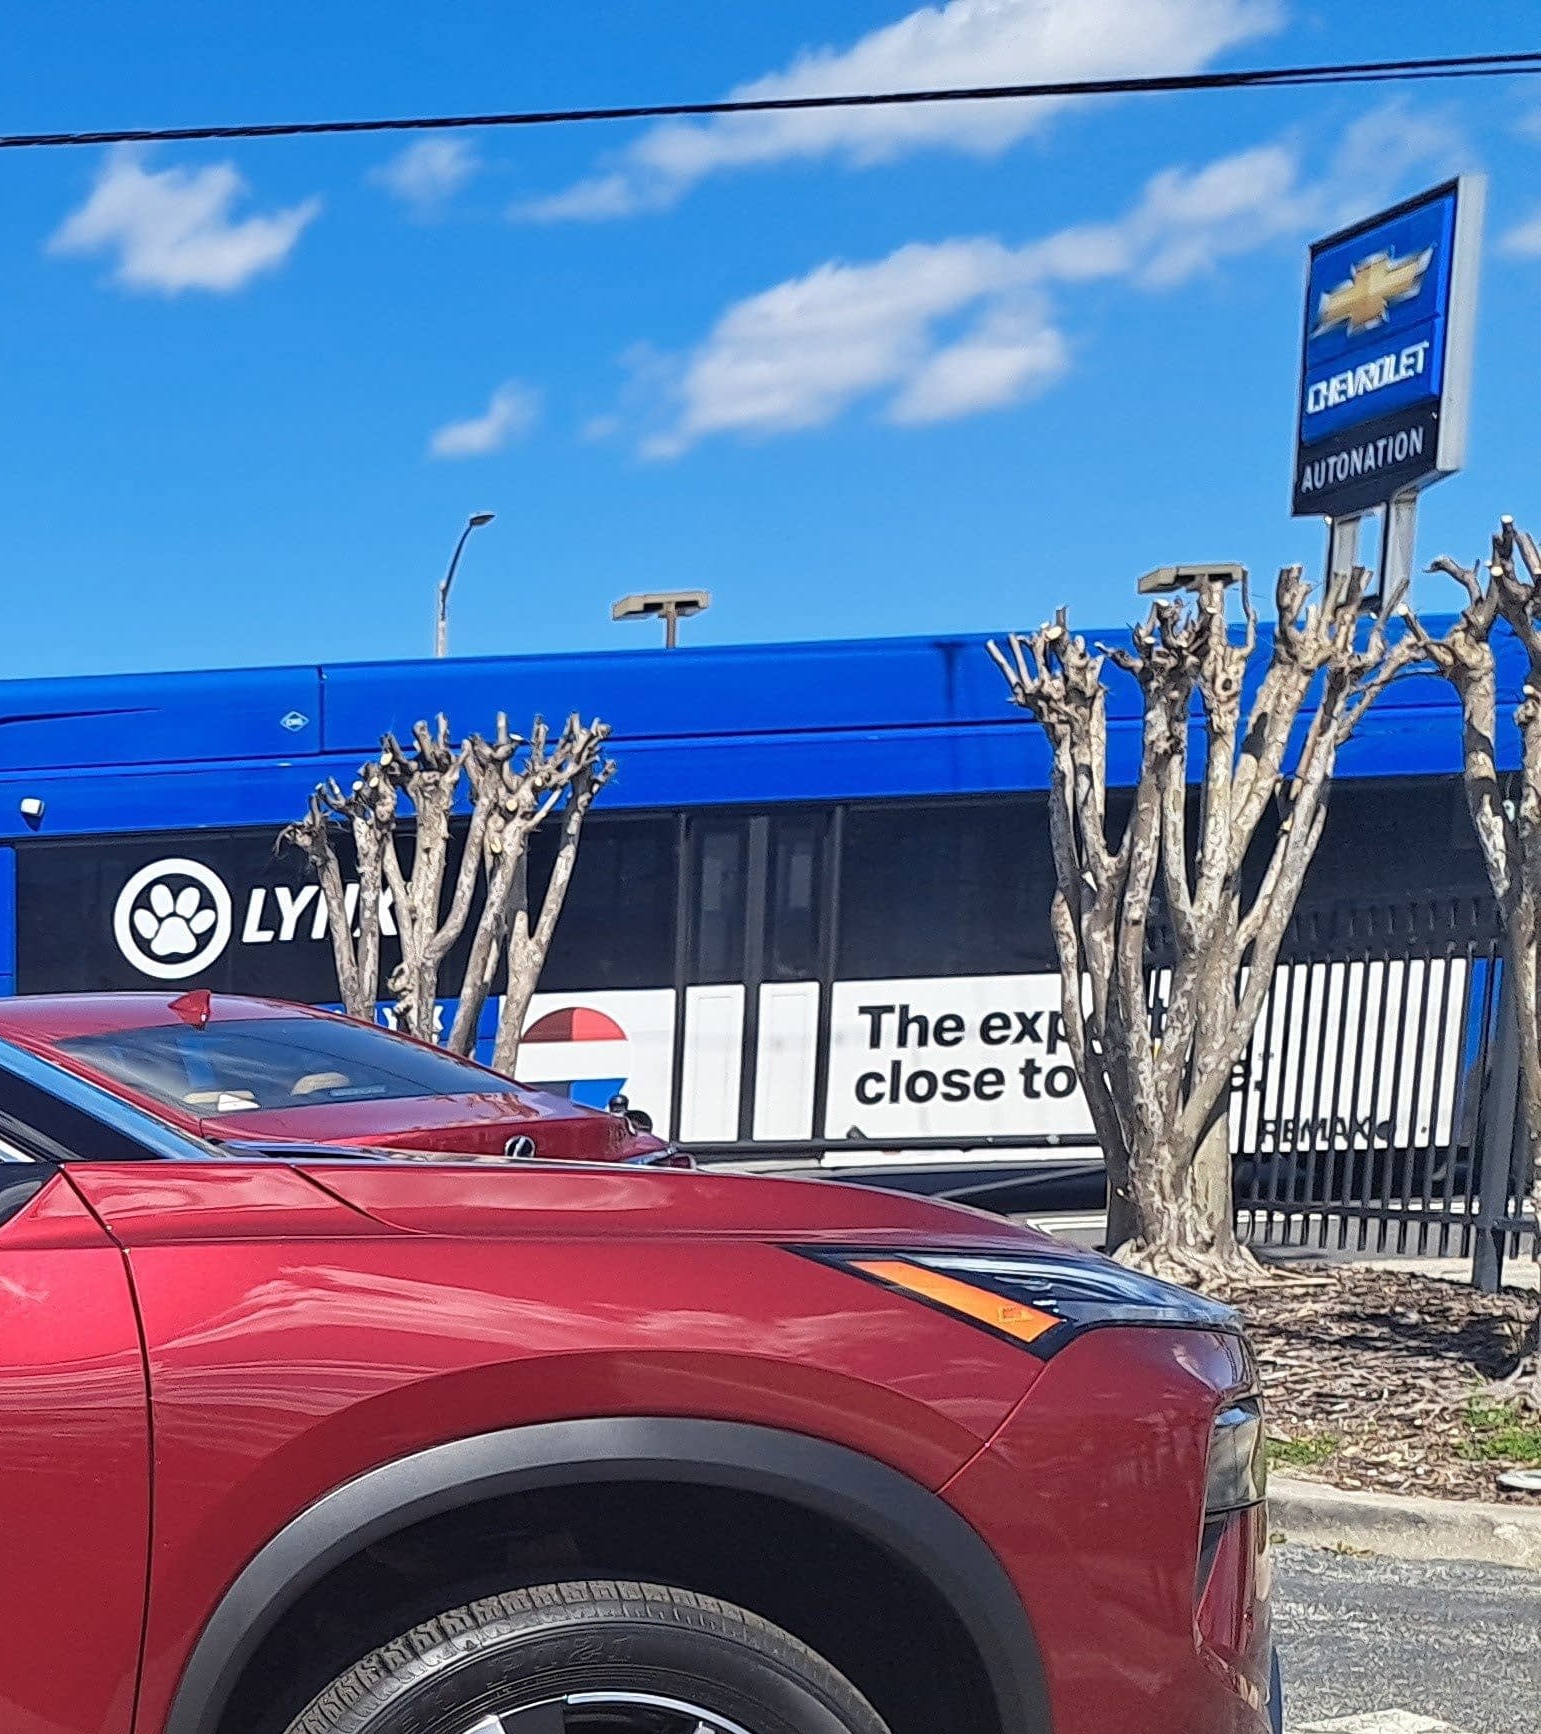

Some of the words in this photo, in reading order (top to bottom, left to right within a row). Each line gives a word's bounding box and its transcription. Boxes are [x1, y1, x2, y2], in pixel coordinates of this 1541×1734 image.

[1306, 341, 1429, 414] CHEVROLET
[1301, 426, 1423, 494] AUTONATION
[858, 1003, 966, 1049] The
[855, 1060, 1006, 1105] close
[1019, 1058, 1078, 1099] to
